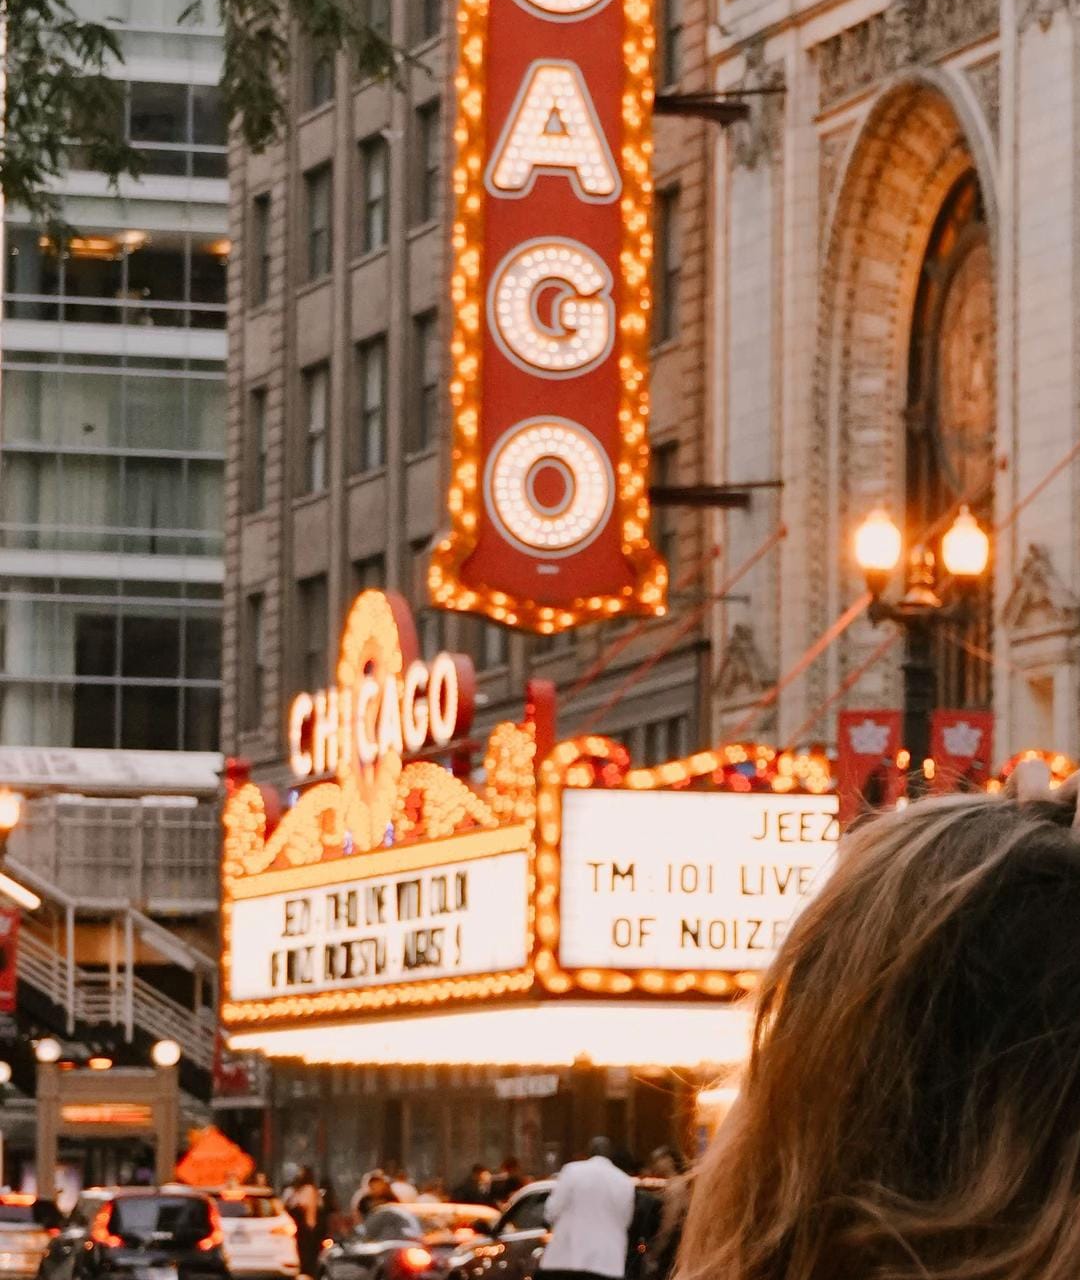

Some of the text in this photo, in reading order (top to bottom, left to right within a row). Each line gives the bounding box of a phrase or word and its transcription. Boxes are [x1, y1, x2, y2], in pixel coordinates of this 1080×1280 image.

[289, 651, 458, 780] CHICAGO
[741, 865, 813, 896] LIVE
[611, 917, 656, 949] OF
